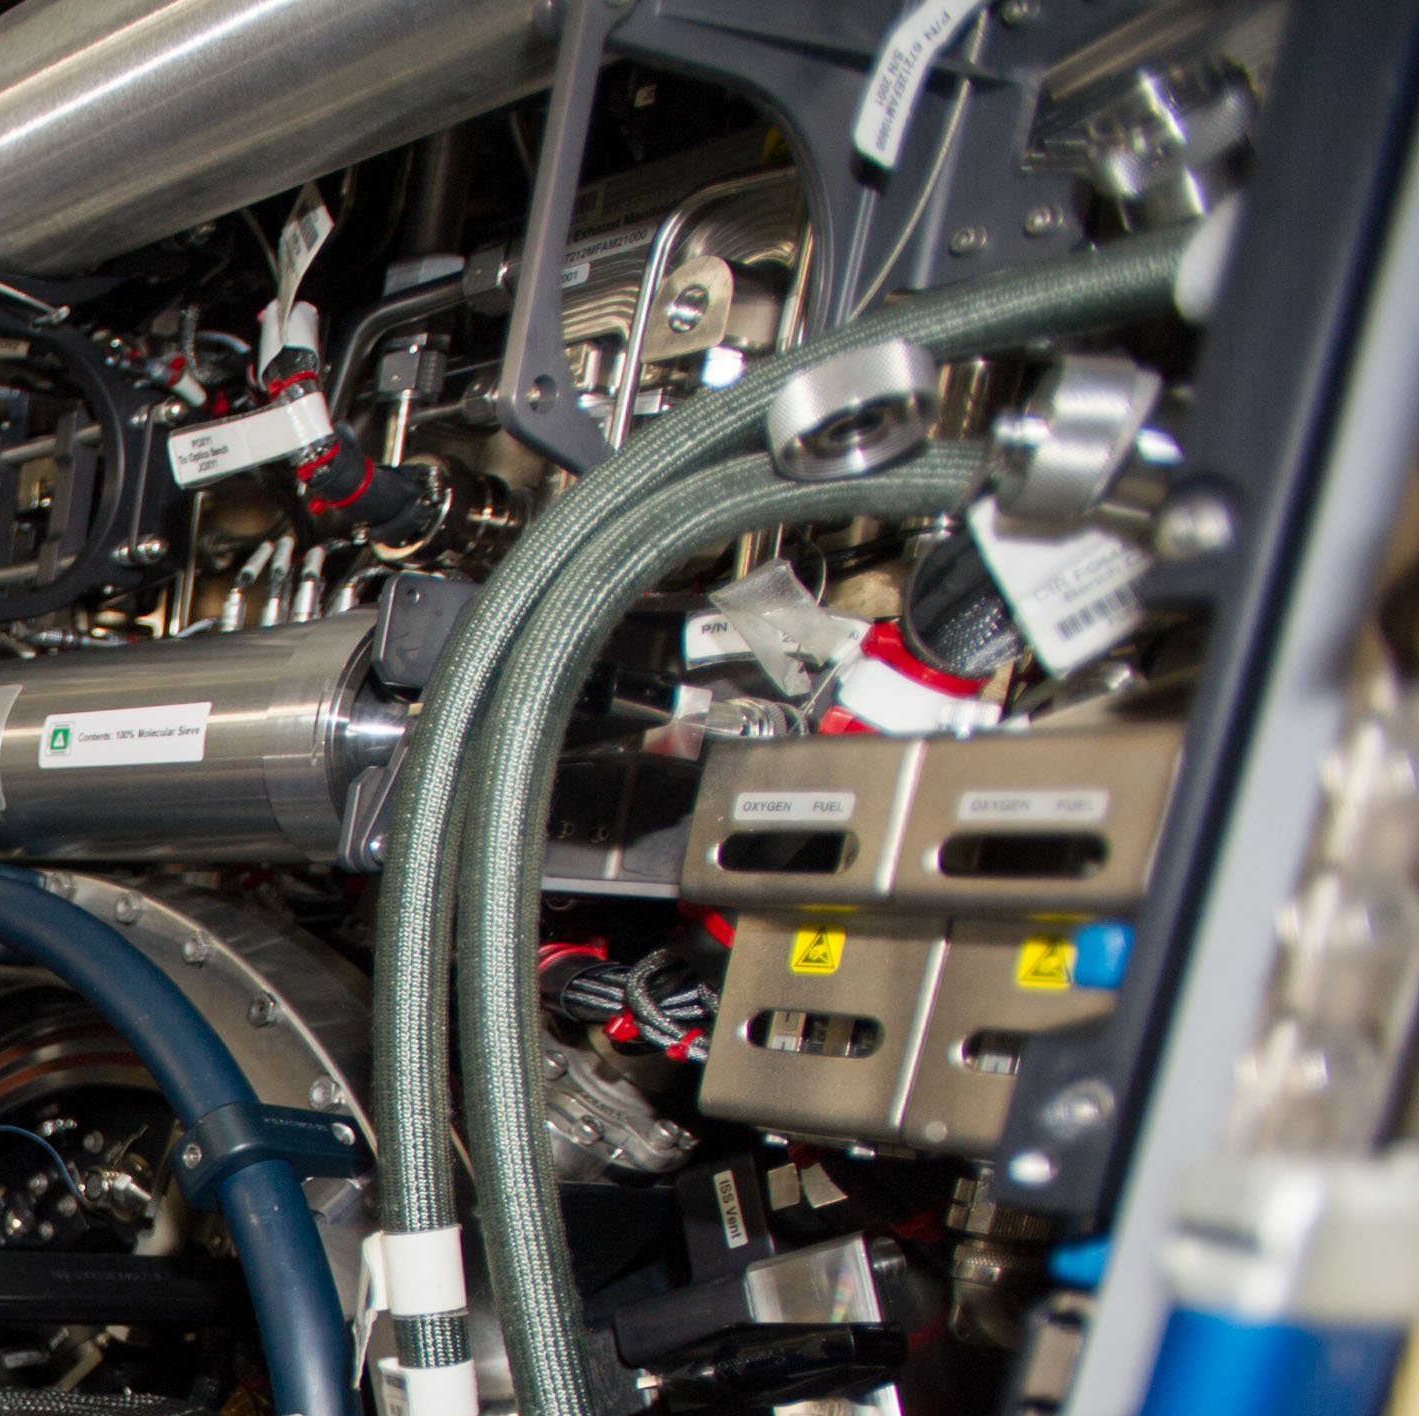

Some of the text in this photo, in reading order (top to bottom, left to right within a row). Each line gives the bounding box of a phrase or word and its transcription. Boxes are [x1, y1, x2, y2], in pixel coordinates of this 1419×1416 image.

[564, 229, 648, 263] 7212MFAM21000
[562, 271, 578, 283] 001
[701, 622, 728, 634] P/N
[137, 727, 175, 739] Molecular
[177, 725, 200, 736] Sieve
[742, 801, 844, 812] OXYGEN FUEL
[718, 1179, 742, 1239] ISS Vent
